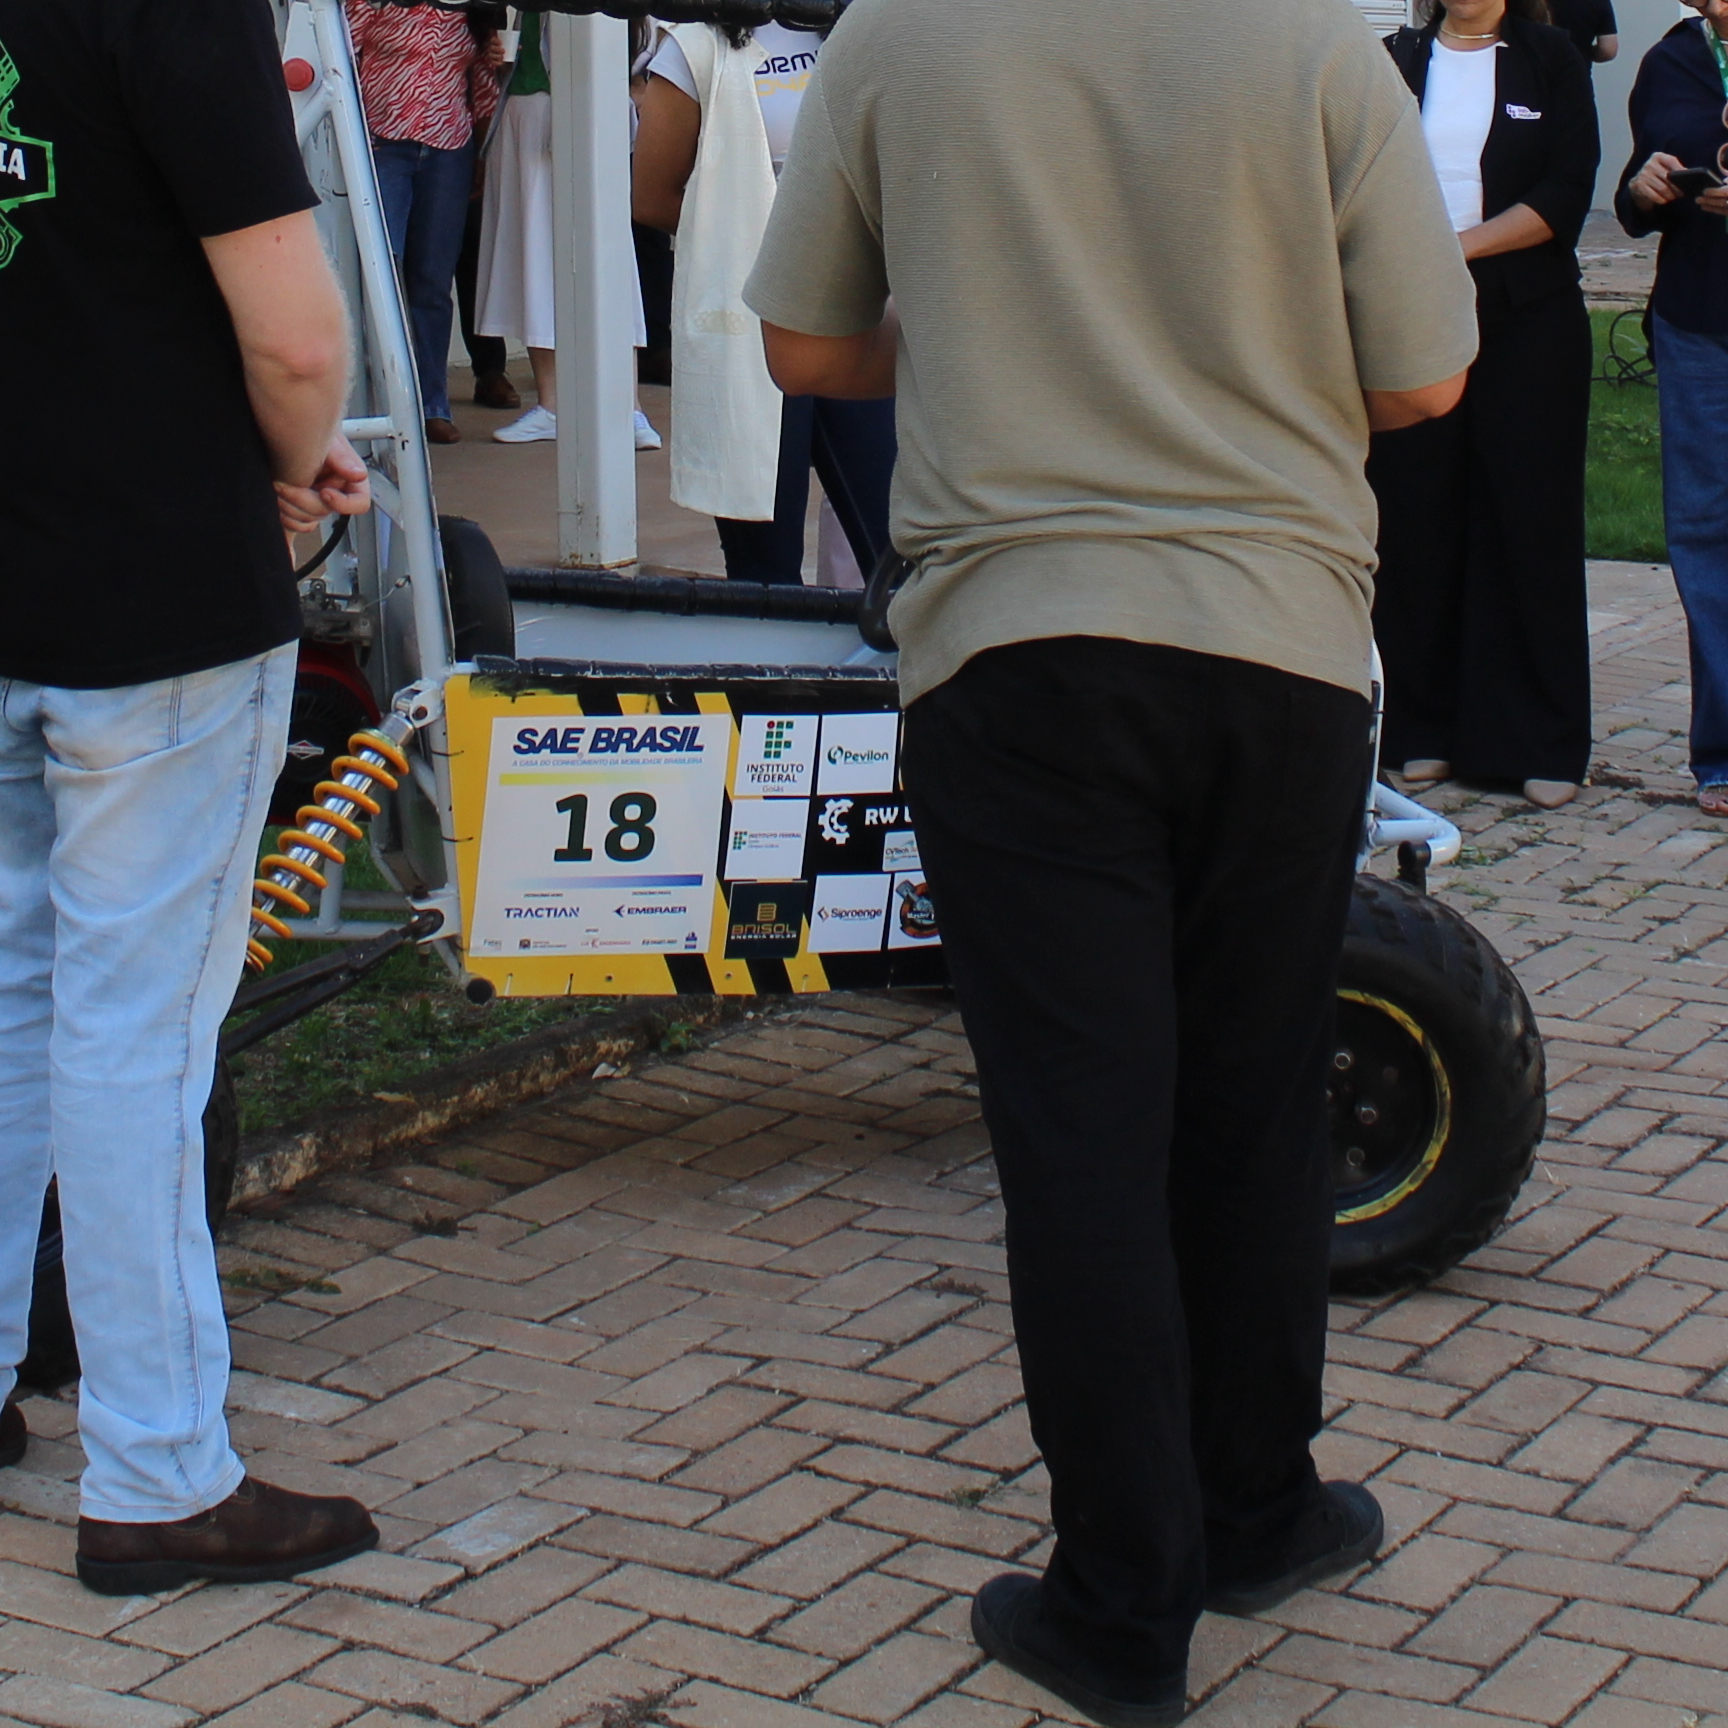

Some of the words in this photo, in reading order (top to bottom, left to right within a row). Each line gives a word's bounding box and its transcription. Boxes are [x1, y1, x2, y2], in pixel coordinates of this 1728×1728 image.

[513, 726, 586, 755] SAE
[589, 725, 705, 753] BRASIL
[843, 750, 890, 762] Pevilon
[746, 763, 804, 773] INSTITUTO
[750, 773, 798, 783] FEDERAL
[865, 807, 899, 826] RW
[553, 791, 657, 863] 18
[504, 906, 580, 919] TRACTIAN
[627, 905, 687, 915] EMBRAER
[831, 907, 883, 920] Siproenge
